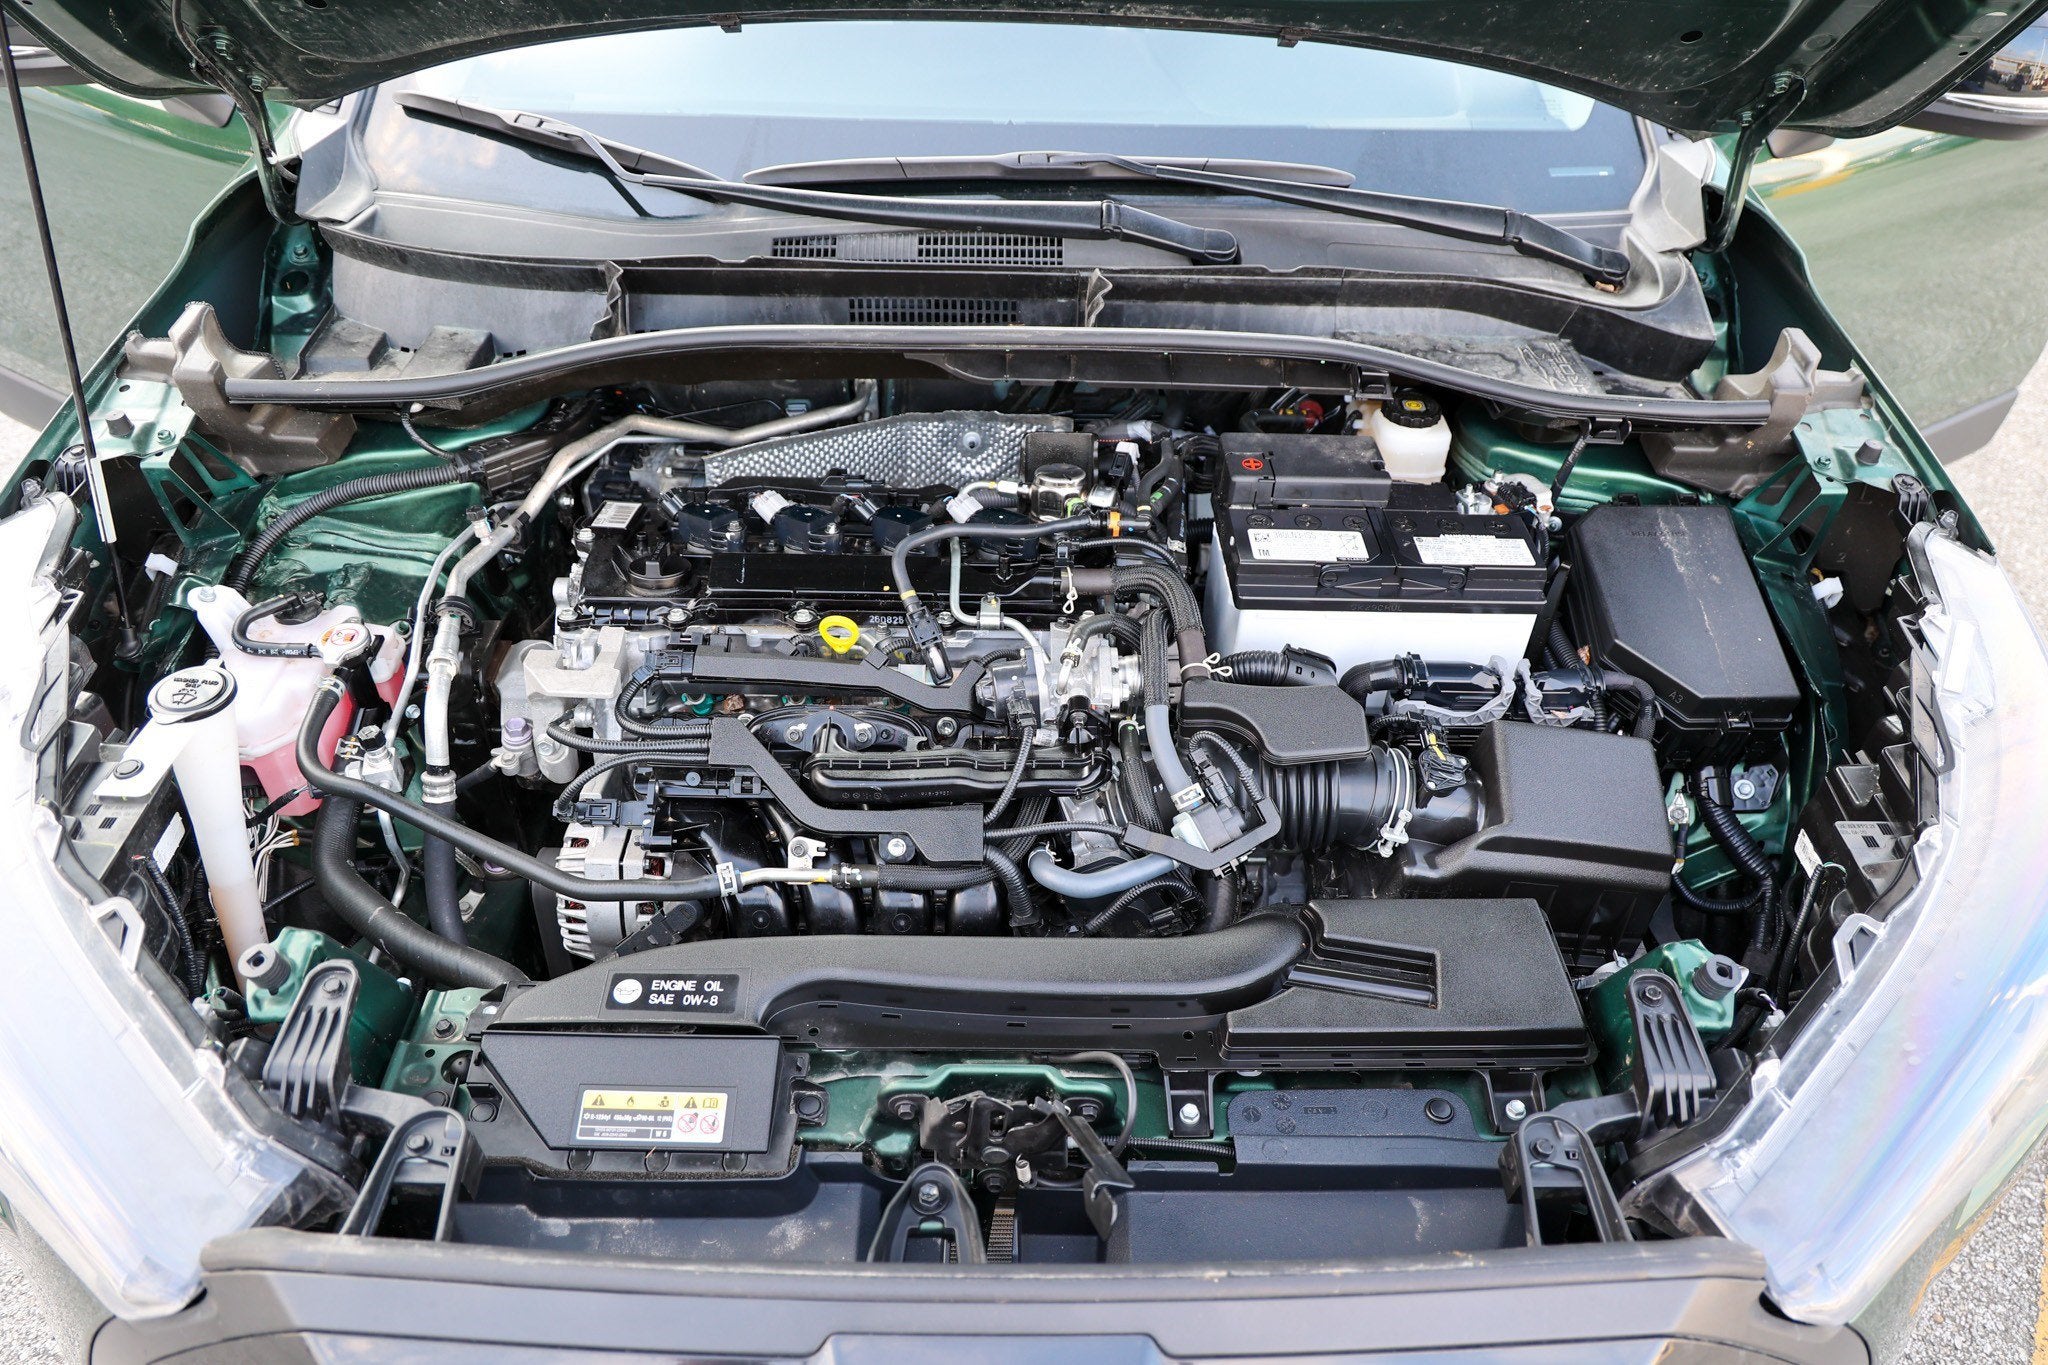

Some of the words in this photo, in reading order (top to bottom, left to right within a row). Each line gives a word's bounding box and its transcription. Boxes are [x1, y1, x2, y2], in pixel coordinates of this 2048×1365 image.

[1258, 548, 1271, 557] TM
[1668, 691, 1684, 704] A3
[651, 980, 697, 991] ENGINE
[703, 980, 724, 992] OIL
[648, 993, 675, 1004] SAE
[682, 994, 719, 1006] 0W-8
